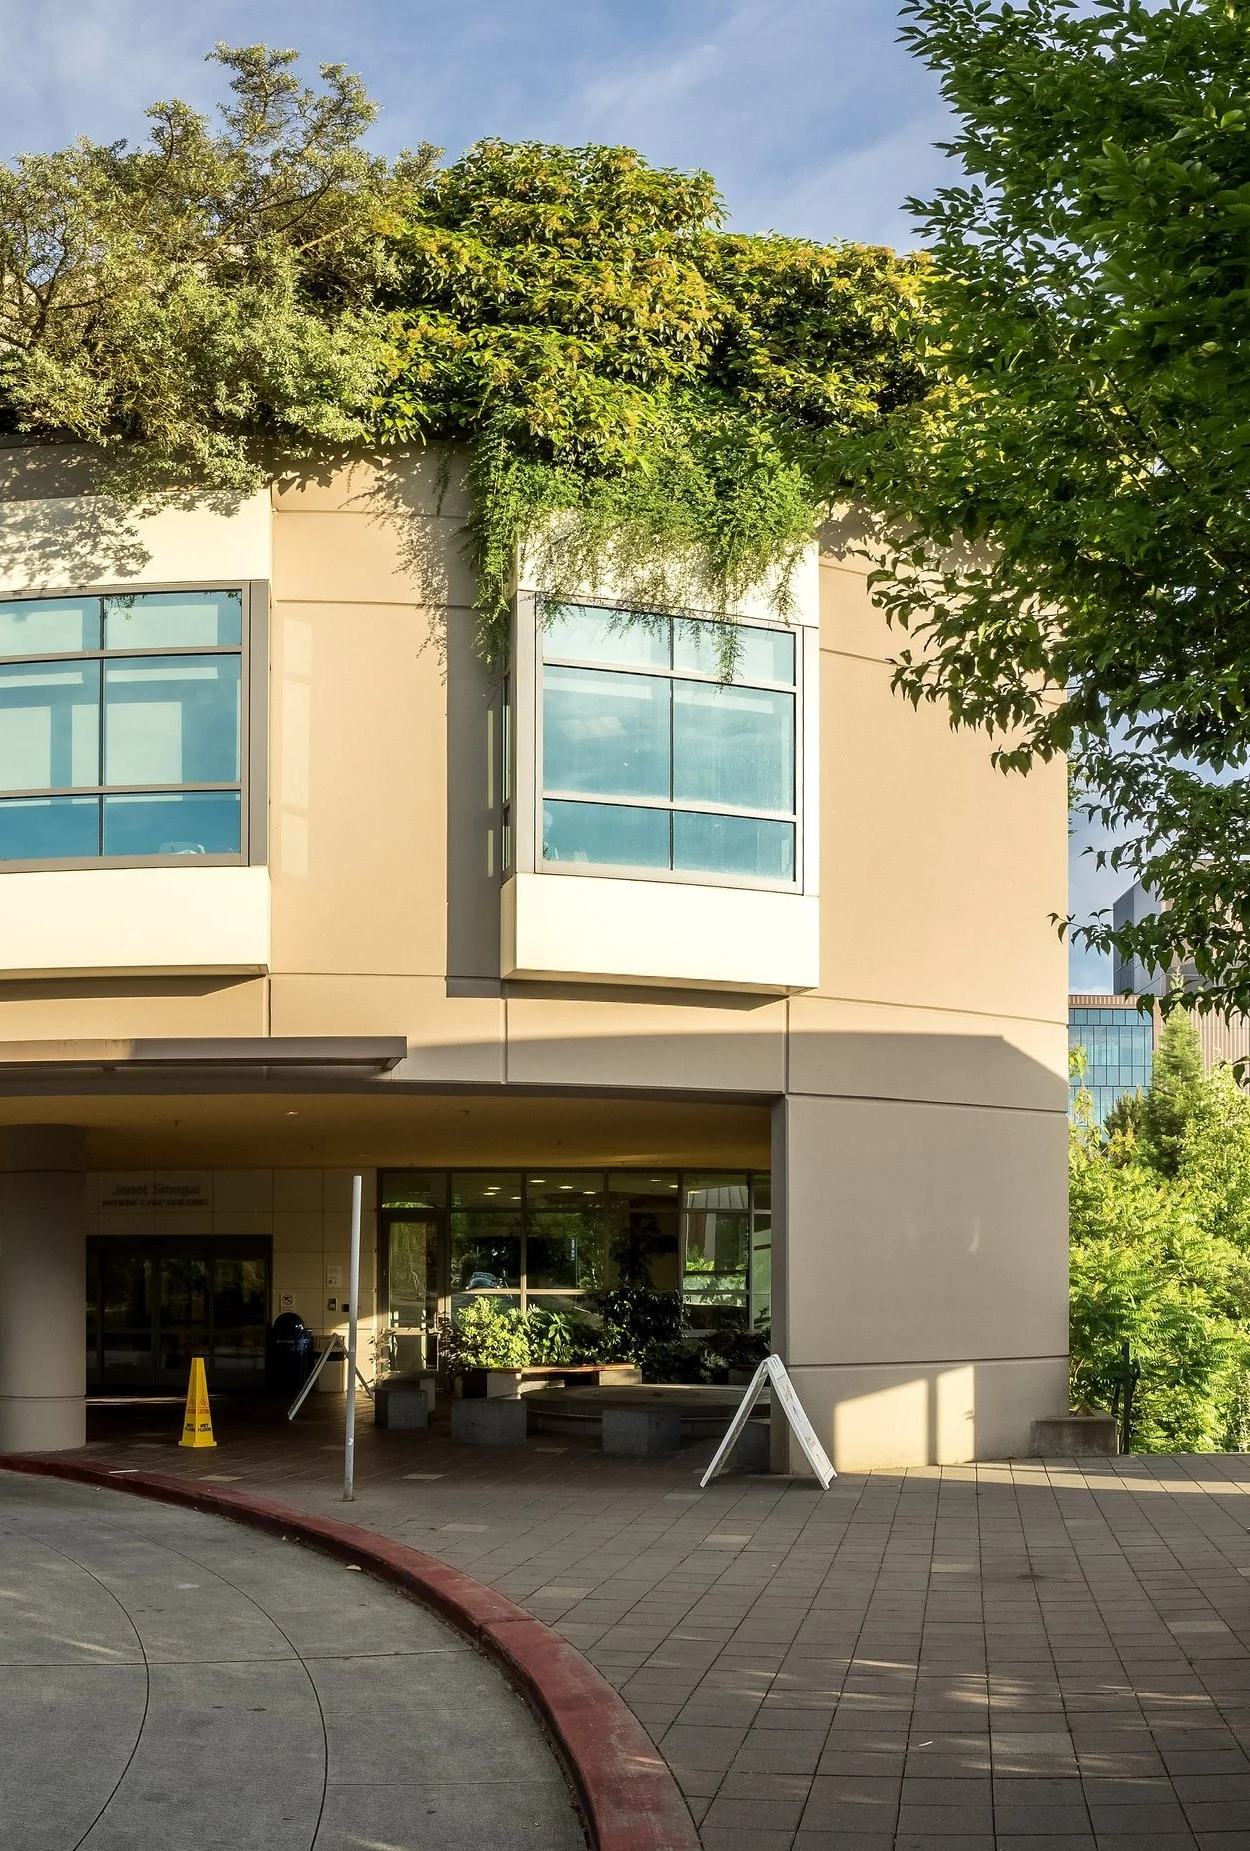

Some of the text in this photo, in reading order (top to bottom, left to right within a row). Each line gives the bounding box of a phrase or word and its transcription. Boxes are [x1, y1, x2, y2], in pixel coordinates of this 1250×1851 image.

[112, 1184, 148, 1196] Janet
[102, 1198, 209, 1207] PATIENT CARE BUILDING
